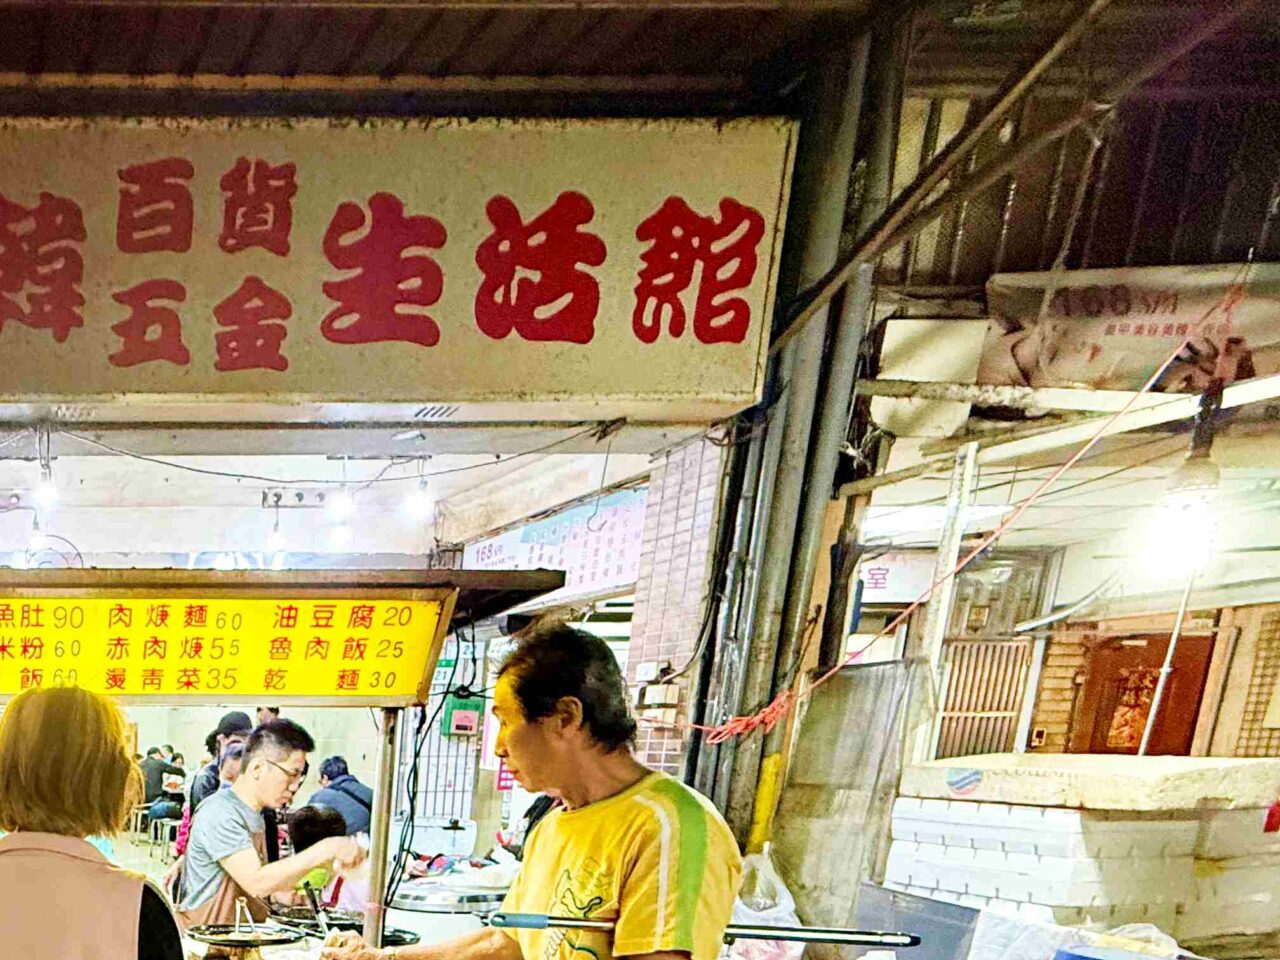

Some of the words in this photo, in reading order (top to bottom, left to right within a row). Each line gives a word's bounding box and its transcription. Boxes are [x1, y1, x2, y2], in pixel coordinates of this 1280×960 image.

[116, 156, 298, 257] 百貨
[320, 191, 767, 346] 生活館
[108, 275, 292, 372] 五金
[53, 606, 84, 629] 90
[215, 611, 243, 631] 60
[273, 604, 375, 629] 油豆腐
[382, 606, 412, 627] 20
[54, 639, 81, 658] 60
[209, 637, 240, 660] 55
[269, 636, 369, 660] 魯肉飯
[375, 639, 404, 658] 25
[105, 667, 202, 691] 燙青菜
[206, 668, 238, 690] 35
[369, 671, 397, 689] 30
